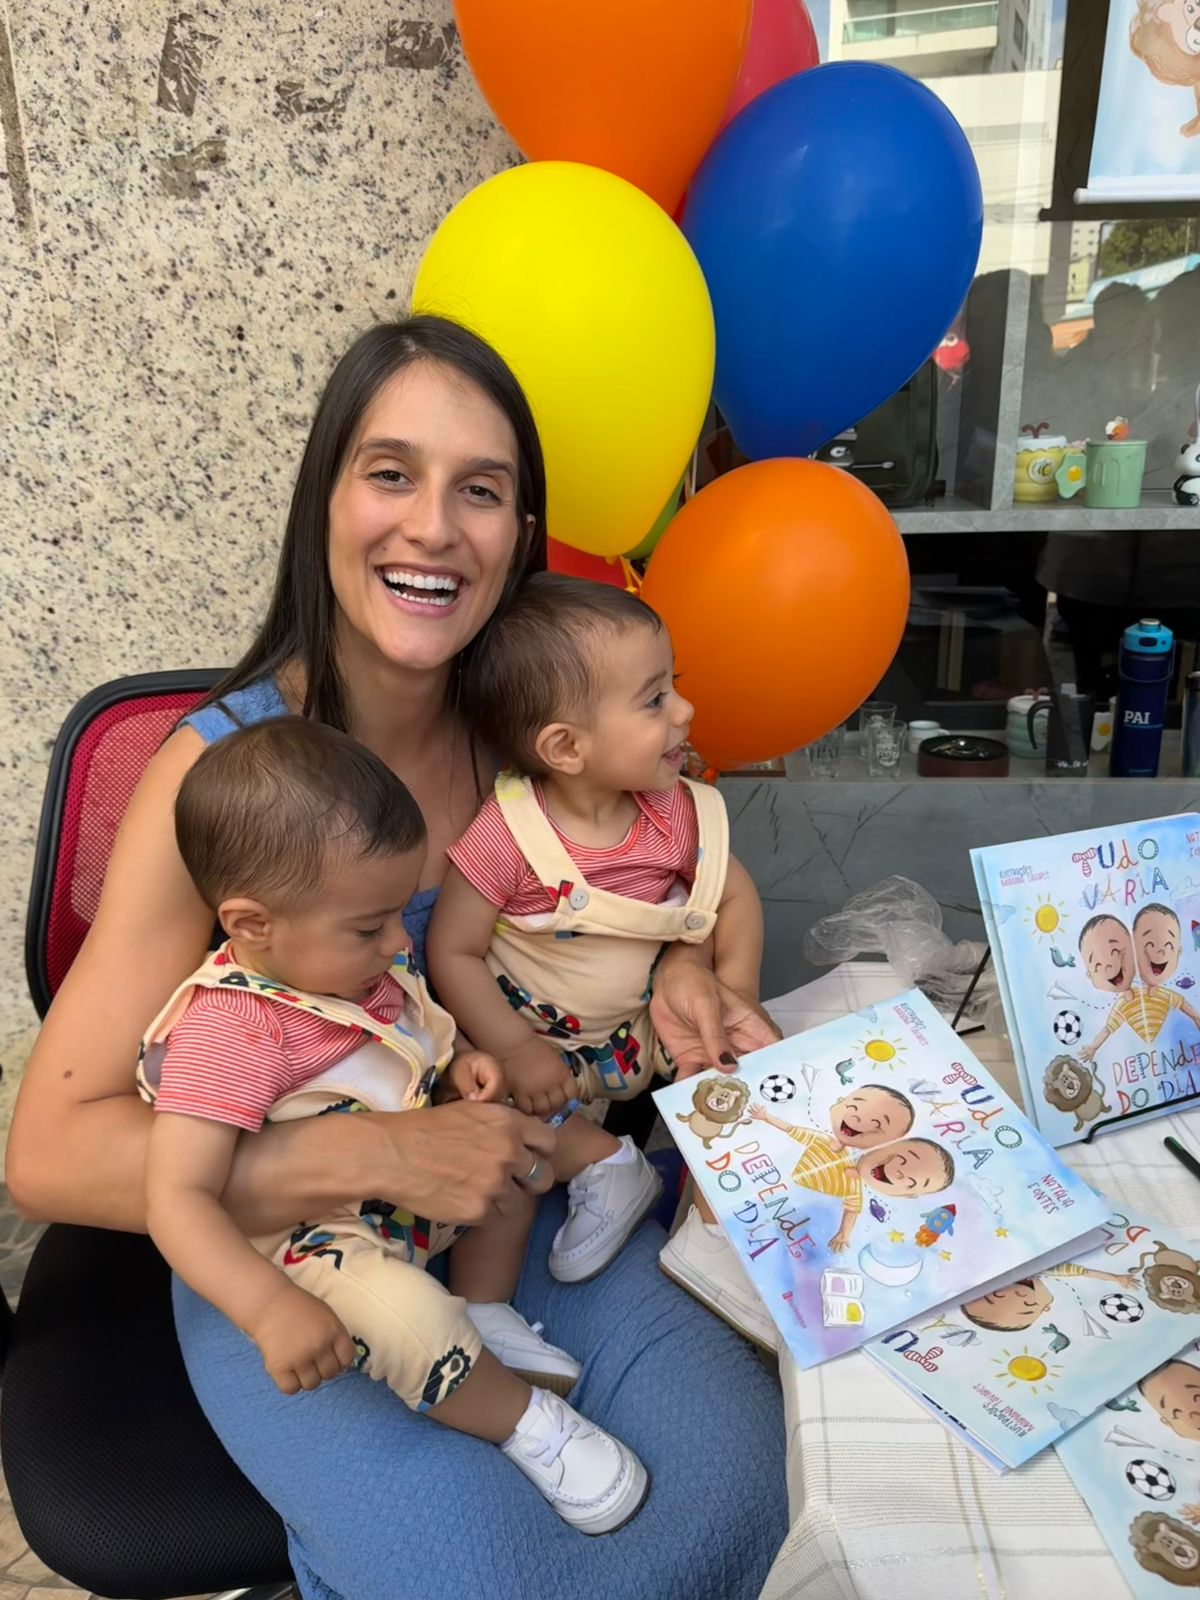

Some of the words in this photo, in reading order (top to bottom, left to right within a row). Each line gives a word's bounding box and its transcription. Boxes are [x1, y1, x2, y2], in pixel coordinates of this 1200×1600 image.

[1124, 710, 1151, 725] PAI
[1116, 1088, 1150, 1115] DO
[705, 1151, 742, 1193] DO
[1027, 1182, 1060, 1214] FONTES
